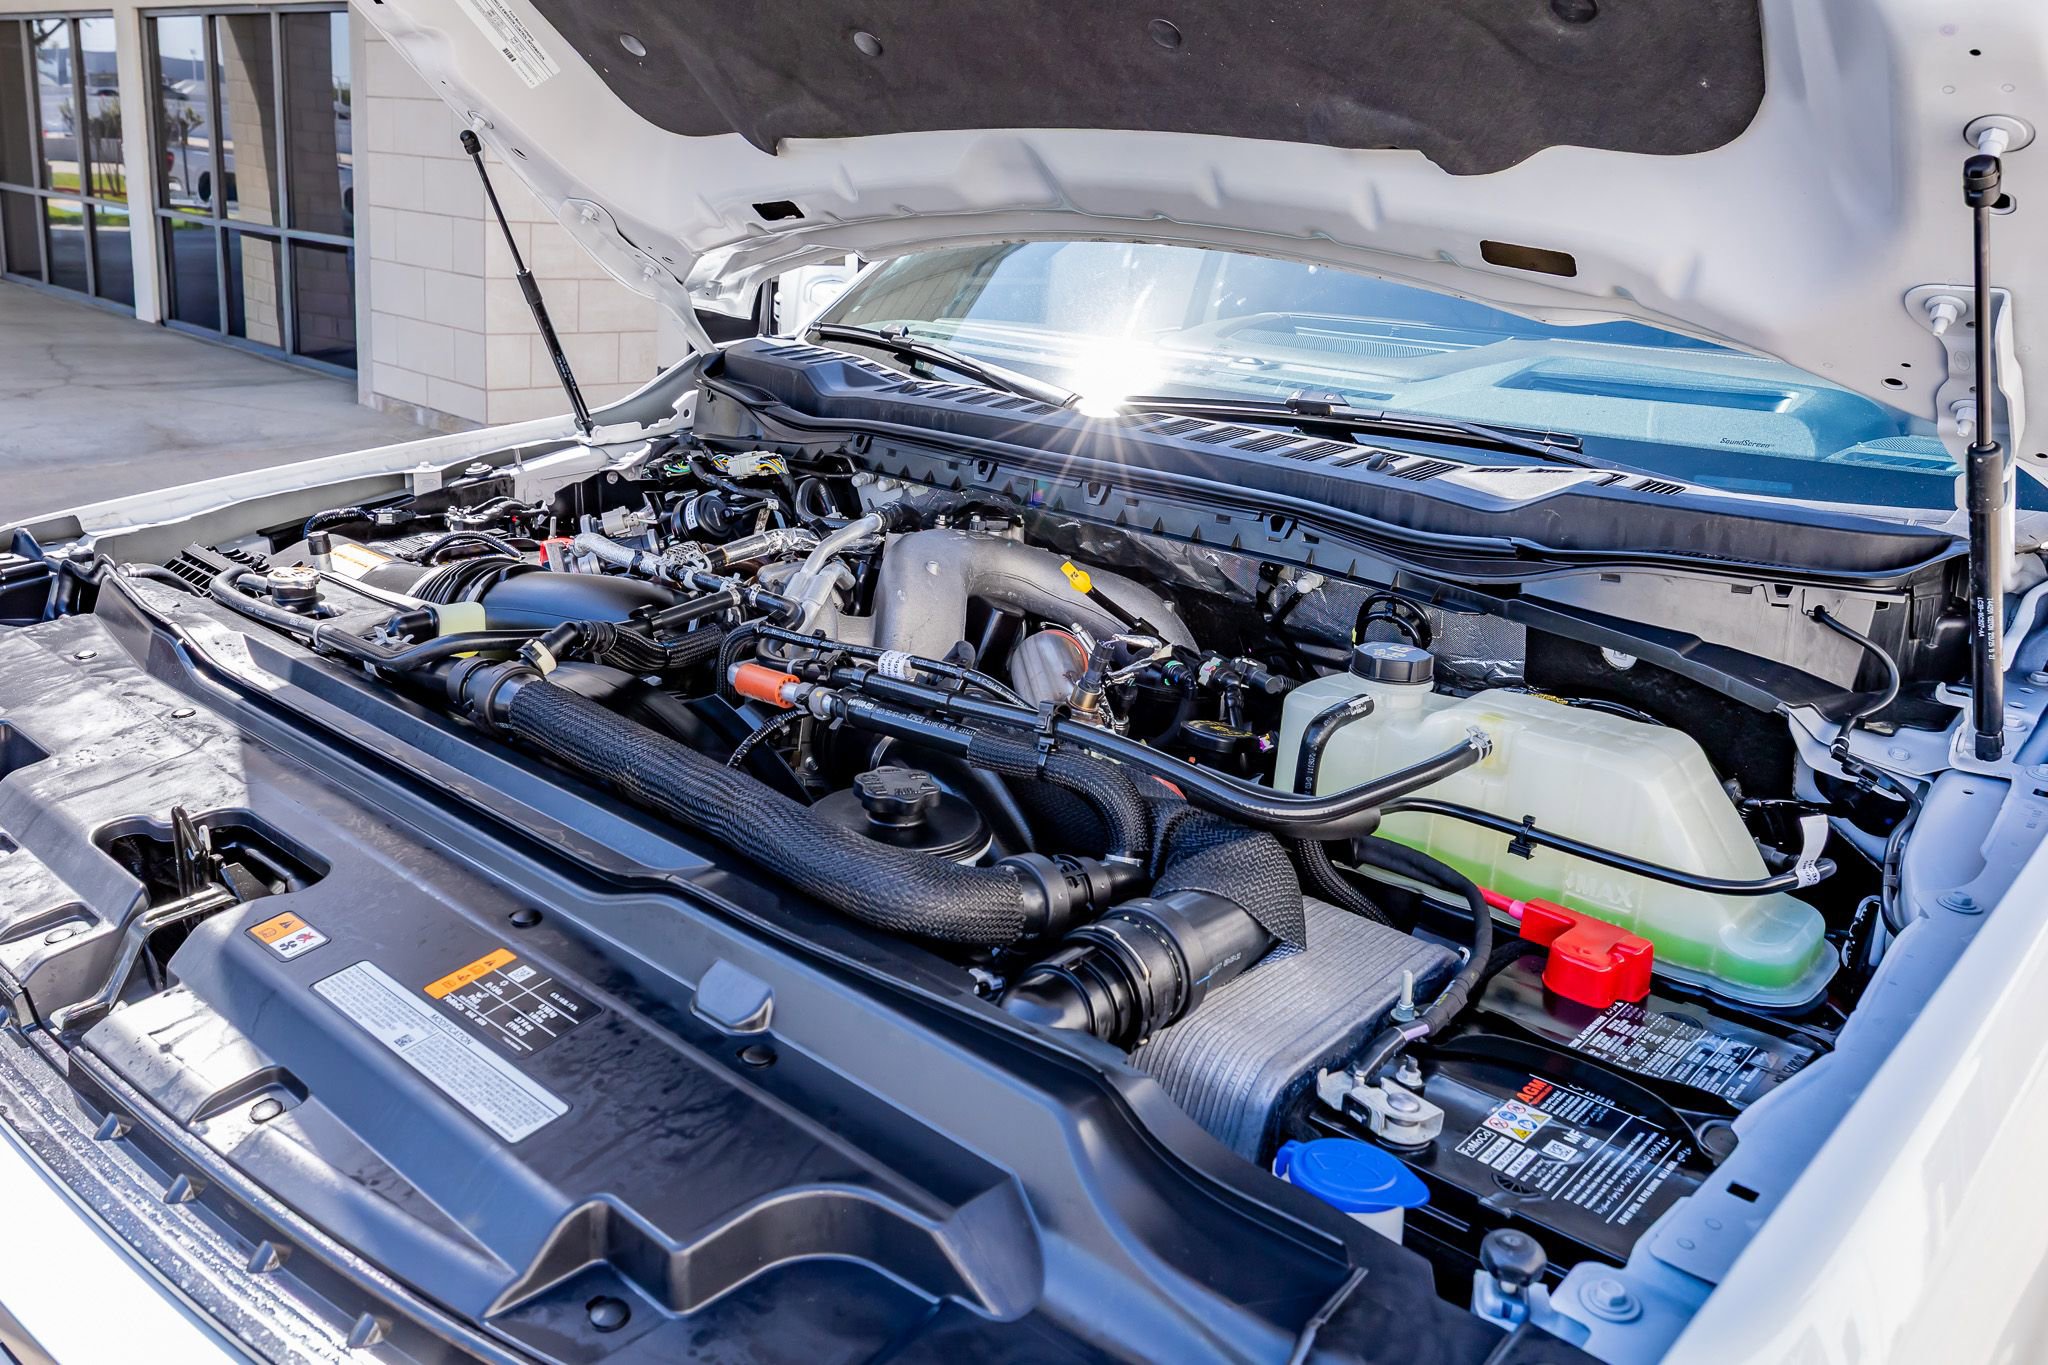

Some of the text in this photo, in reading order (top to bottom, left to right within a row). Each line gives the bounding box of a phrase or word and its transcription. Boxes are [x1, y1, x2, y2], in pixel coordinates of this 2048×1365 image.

[427, 1013, 475, 1046] MODIFICATION
[1513, 1077, 1548, 1103] AGM
[1459, 1129, 1492, 1156] FoMoCo
